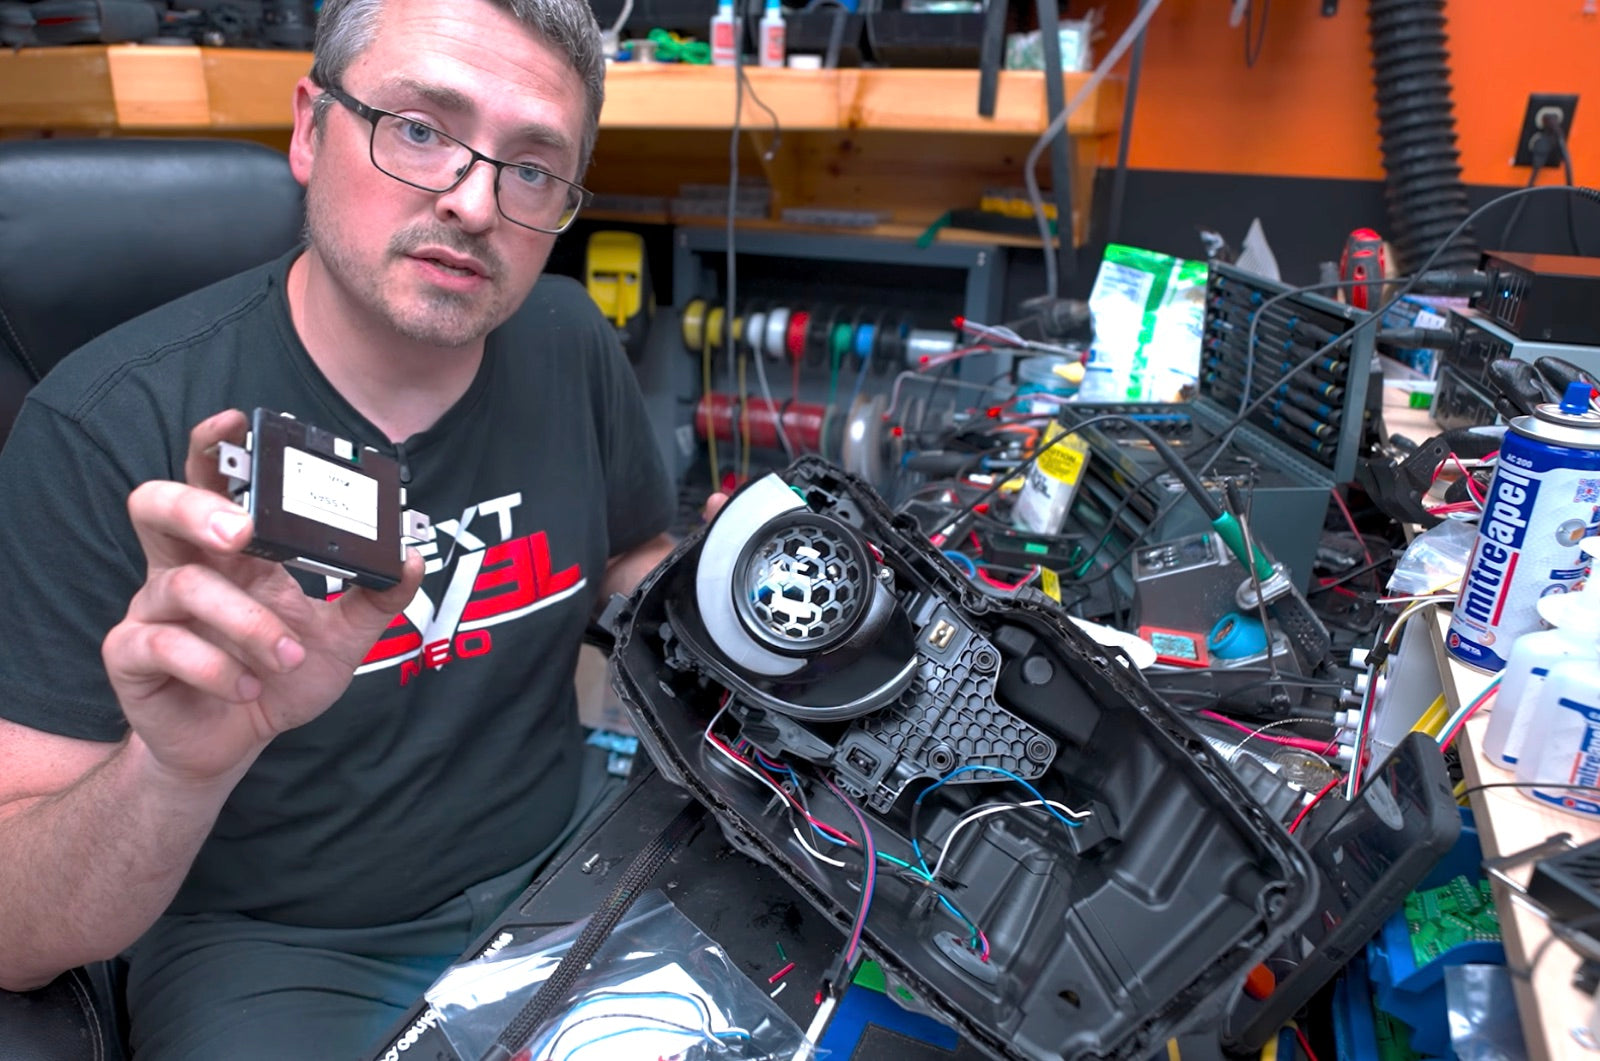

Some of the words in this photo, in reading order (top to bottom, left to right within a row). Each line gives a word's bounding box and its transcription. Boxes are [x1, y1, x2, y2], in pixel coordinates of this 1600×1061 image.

[1517, 457, 1534, 470] 200
[1465, 465, 1530, 624] mitreapel
[401, 629, 492, 686] NEO
